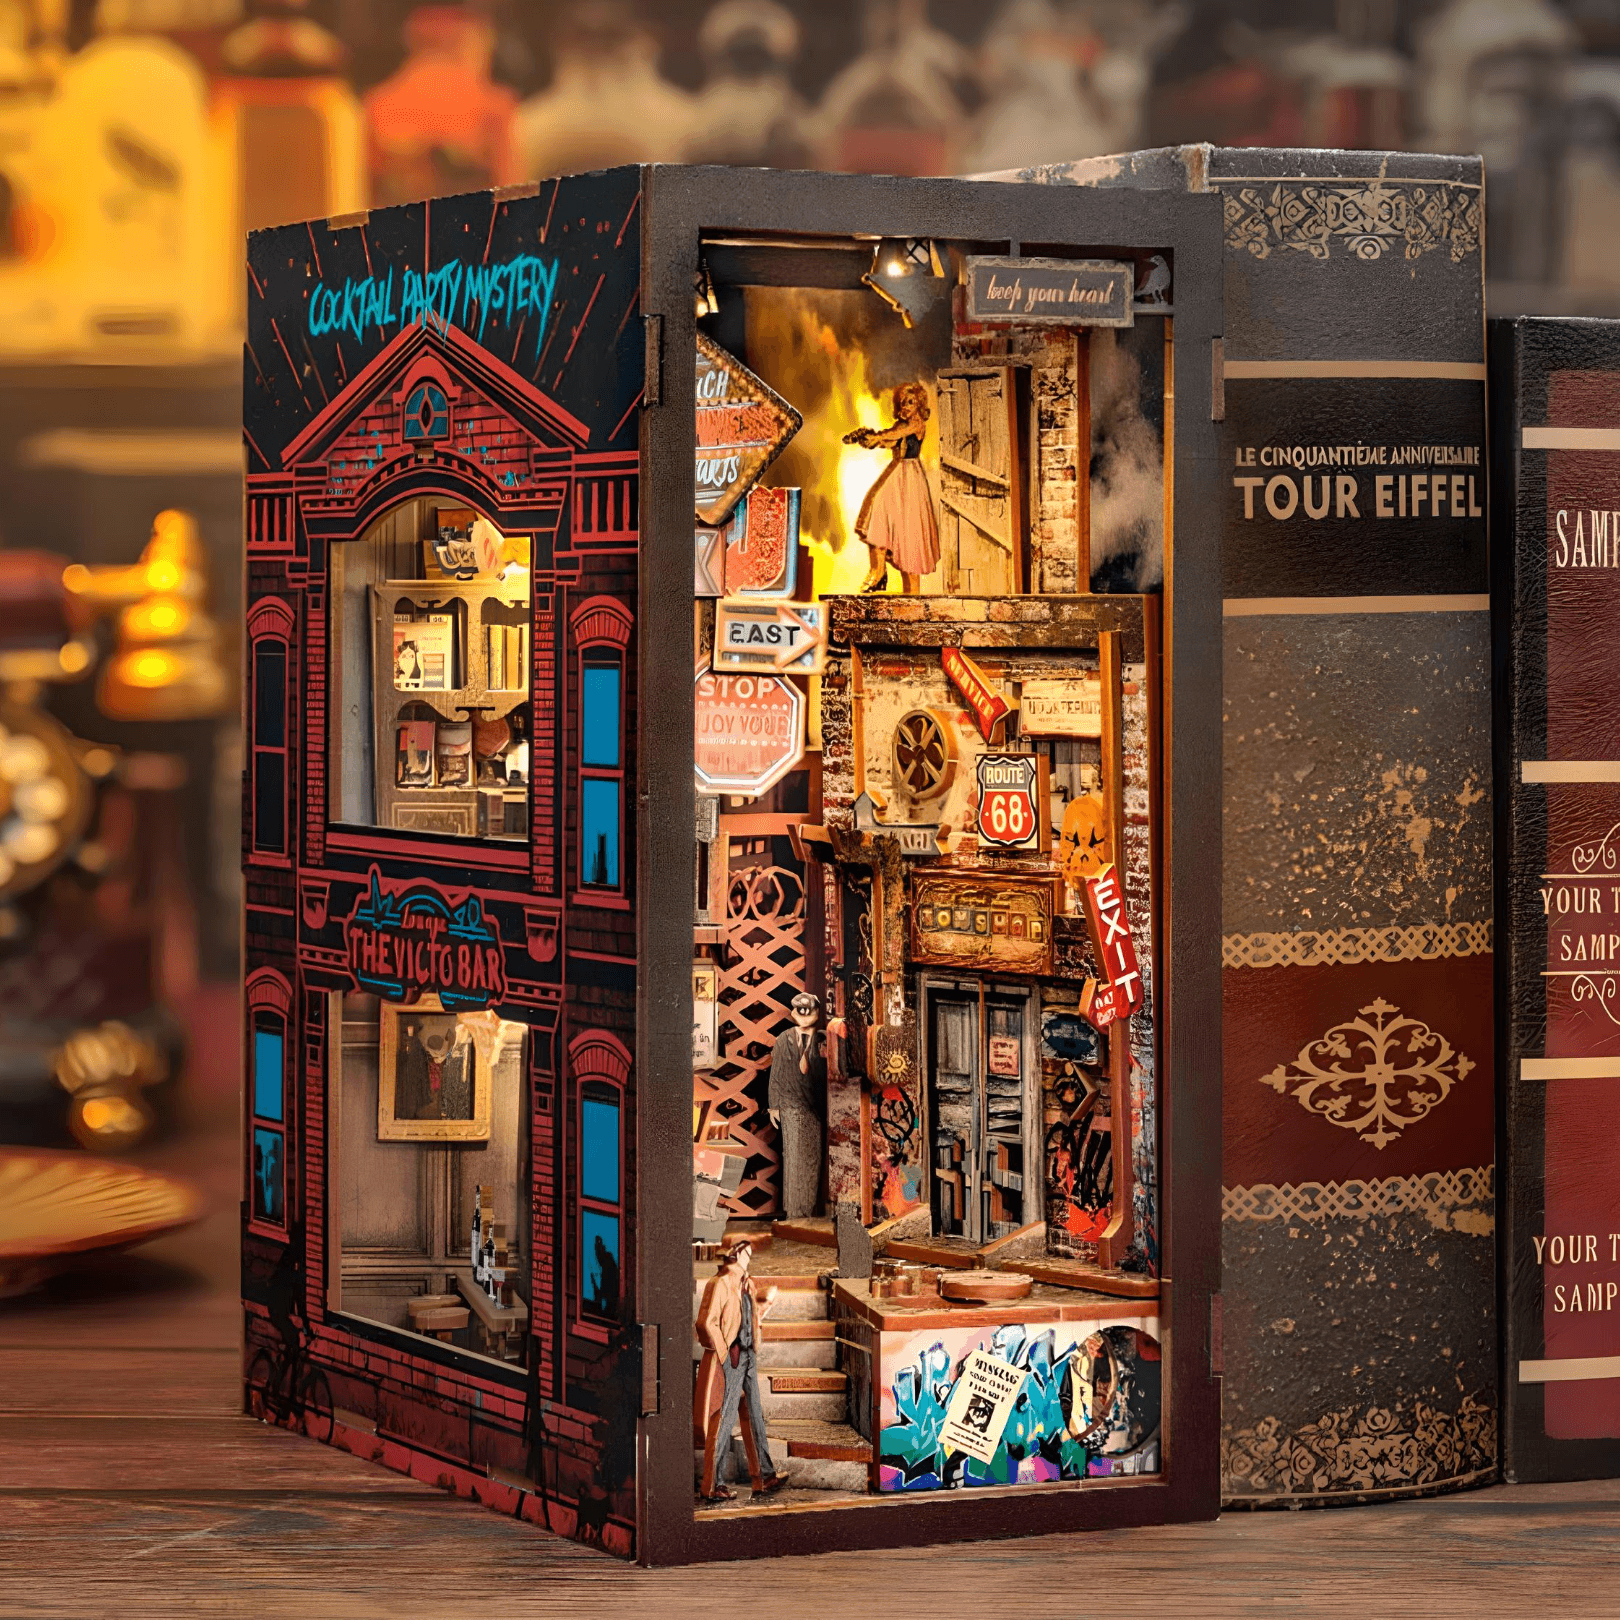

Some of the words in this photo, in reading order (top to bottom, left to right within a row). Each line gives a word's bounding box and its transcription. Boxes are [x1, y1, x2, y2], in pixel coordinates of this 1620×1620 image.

[309, 264, 397, 346] COCKTAIL
[400, 258, 463, 349] PARTY
[462, 252, 559, 365] MYSTERY
[1235, 446, 1257, 467] LE
[1233, 474, 1362, 521] TOUR
[1375, 474, 1483, 518] EIFFEL
[729, 623, 801, 647] EAST
[698, 677, 776, 699] STOP
[986, 766, 1025, 785] ROUTE
[991, 794, 1024, 834] 68
[1539, 886, 1602, 915] YOUR
[1093, 878, 1139, 1003] EXIT
[1560, 934, 1620, 961] SAMP
[350, 927, 394, 975] THE
[457, 944, 503, 993] BAR
[1532, 1235, 1598, 1265] YOUR
[1554, 1282, 1618, 1313] SAMP
